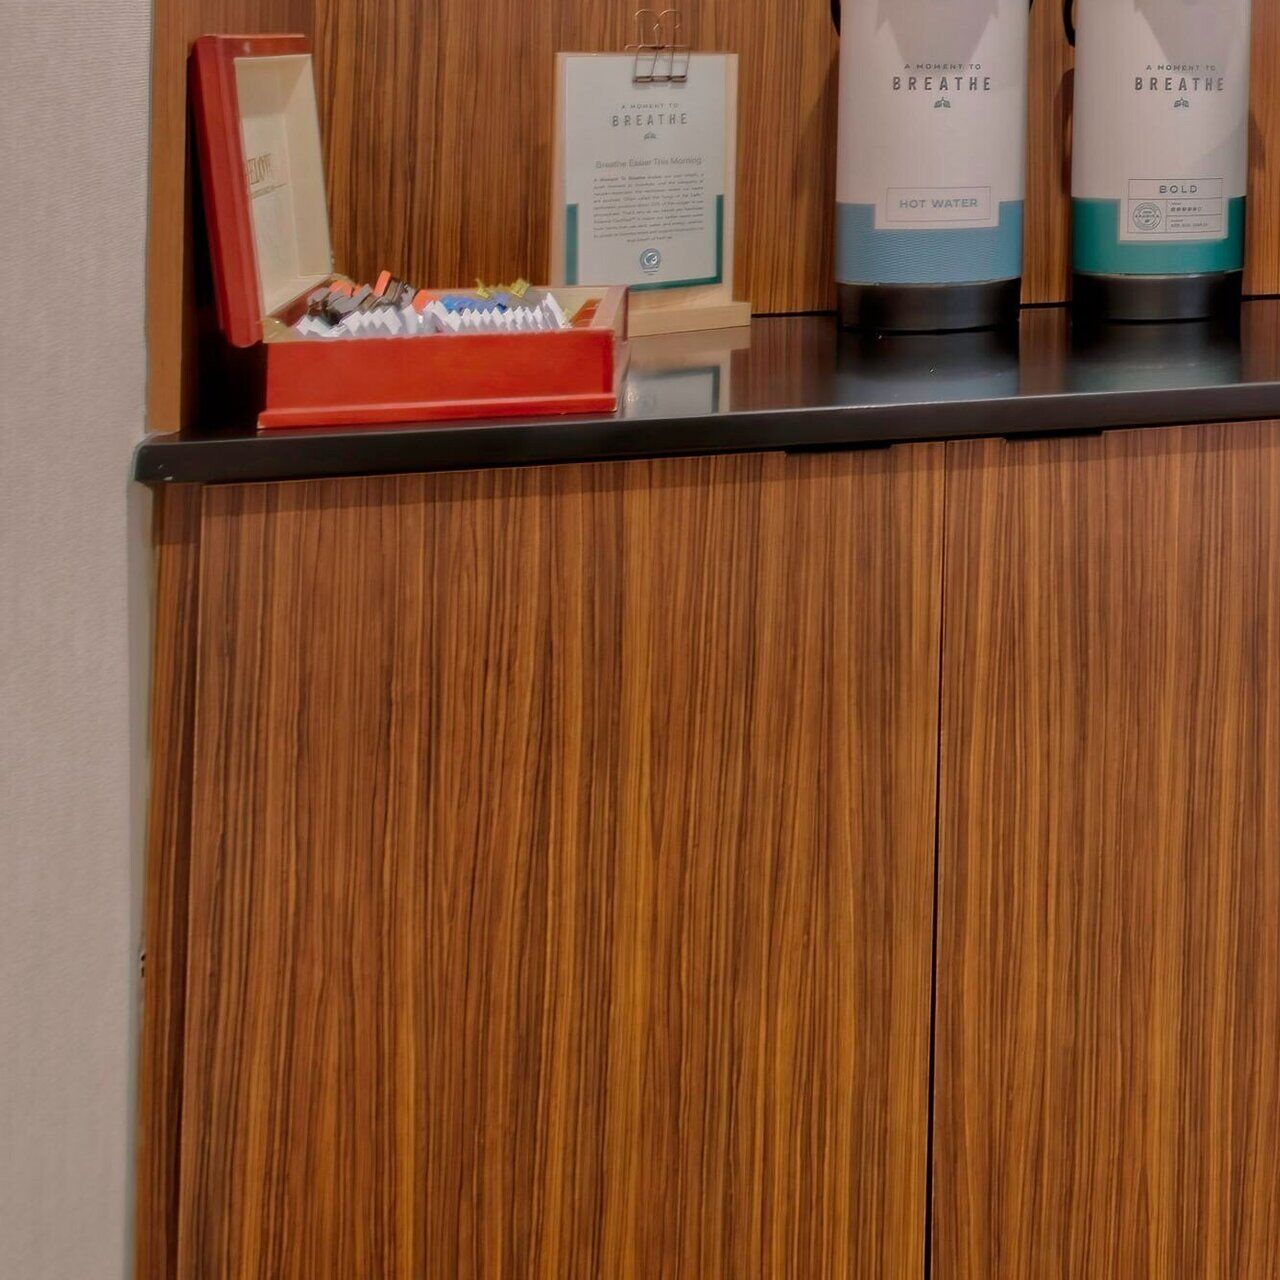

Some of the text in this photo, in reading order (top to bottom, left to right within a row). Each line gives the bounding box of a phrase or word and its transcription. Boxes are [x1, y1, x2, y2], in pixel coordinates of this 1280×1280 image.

[892, 76, 991, 91] BREATHE
[1134, 77, 1224, 91] BREATHE
[611, 112, 688, 127] BREATHE
[670, 157, 702, 166] Morning
[1159, 185, 1198, 194] BOLD
[899, 198, 978, 209] HOT WATER
